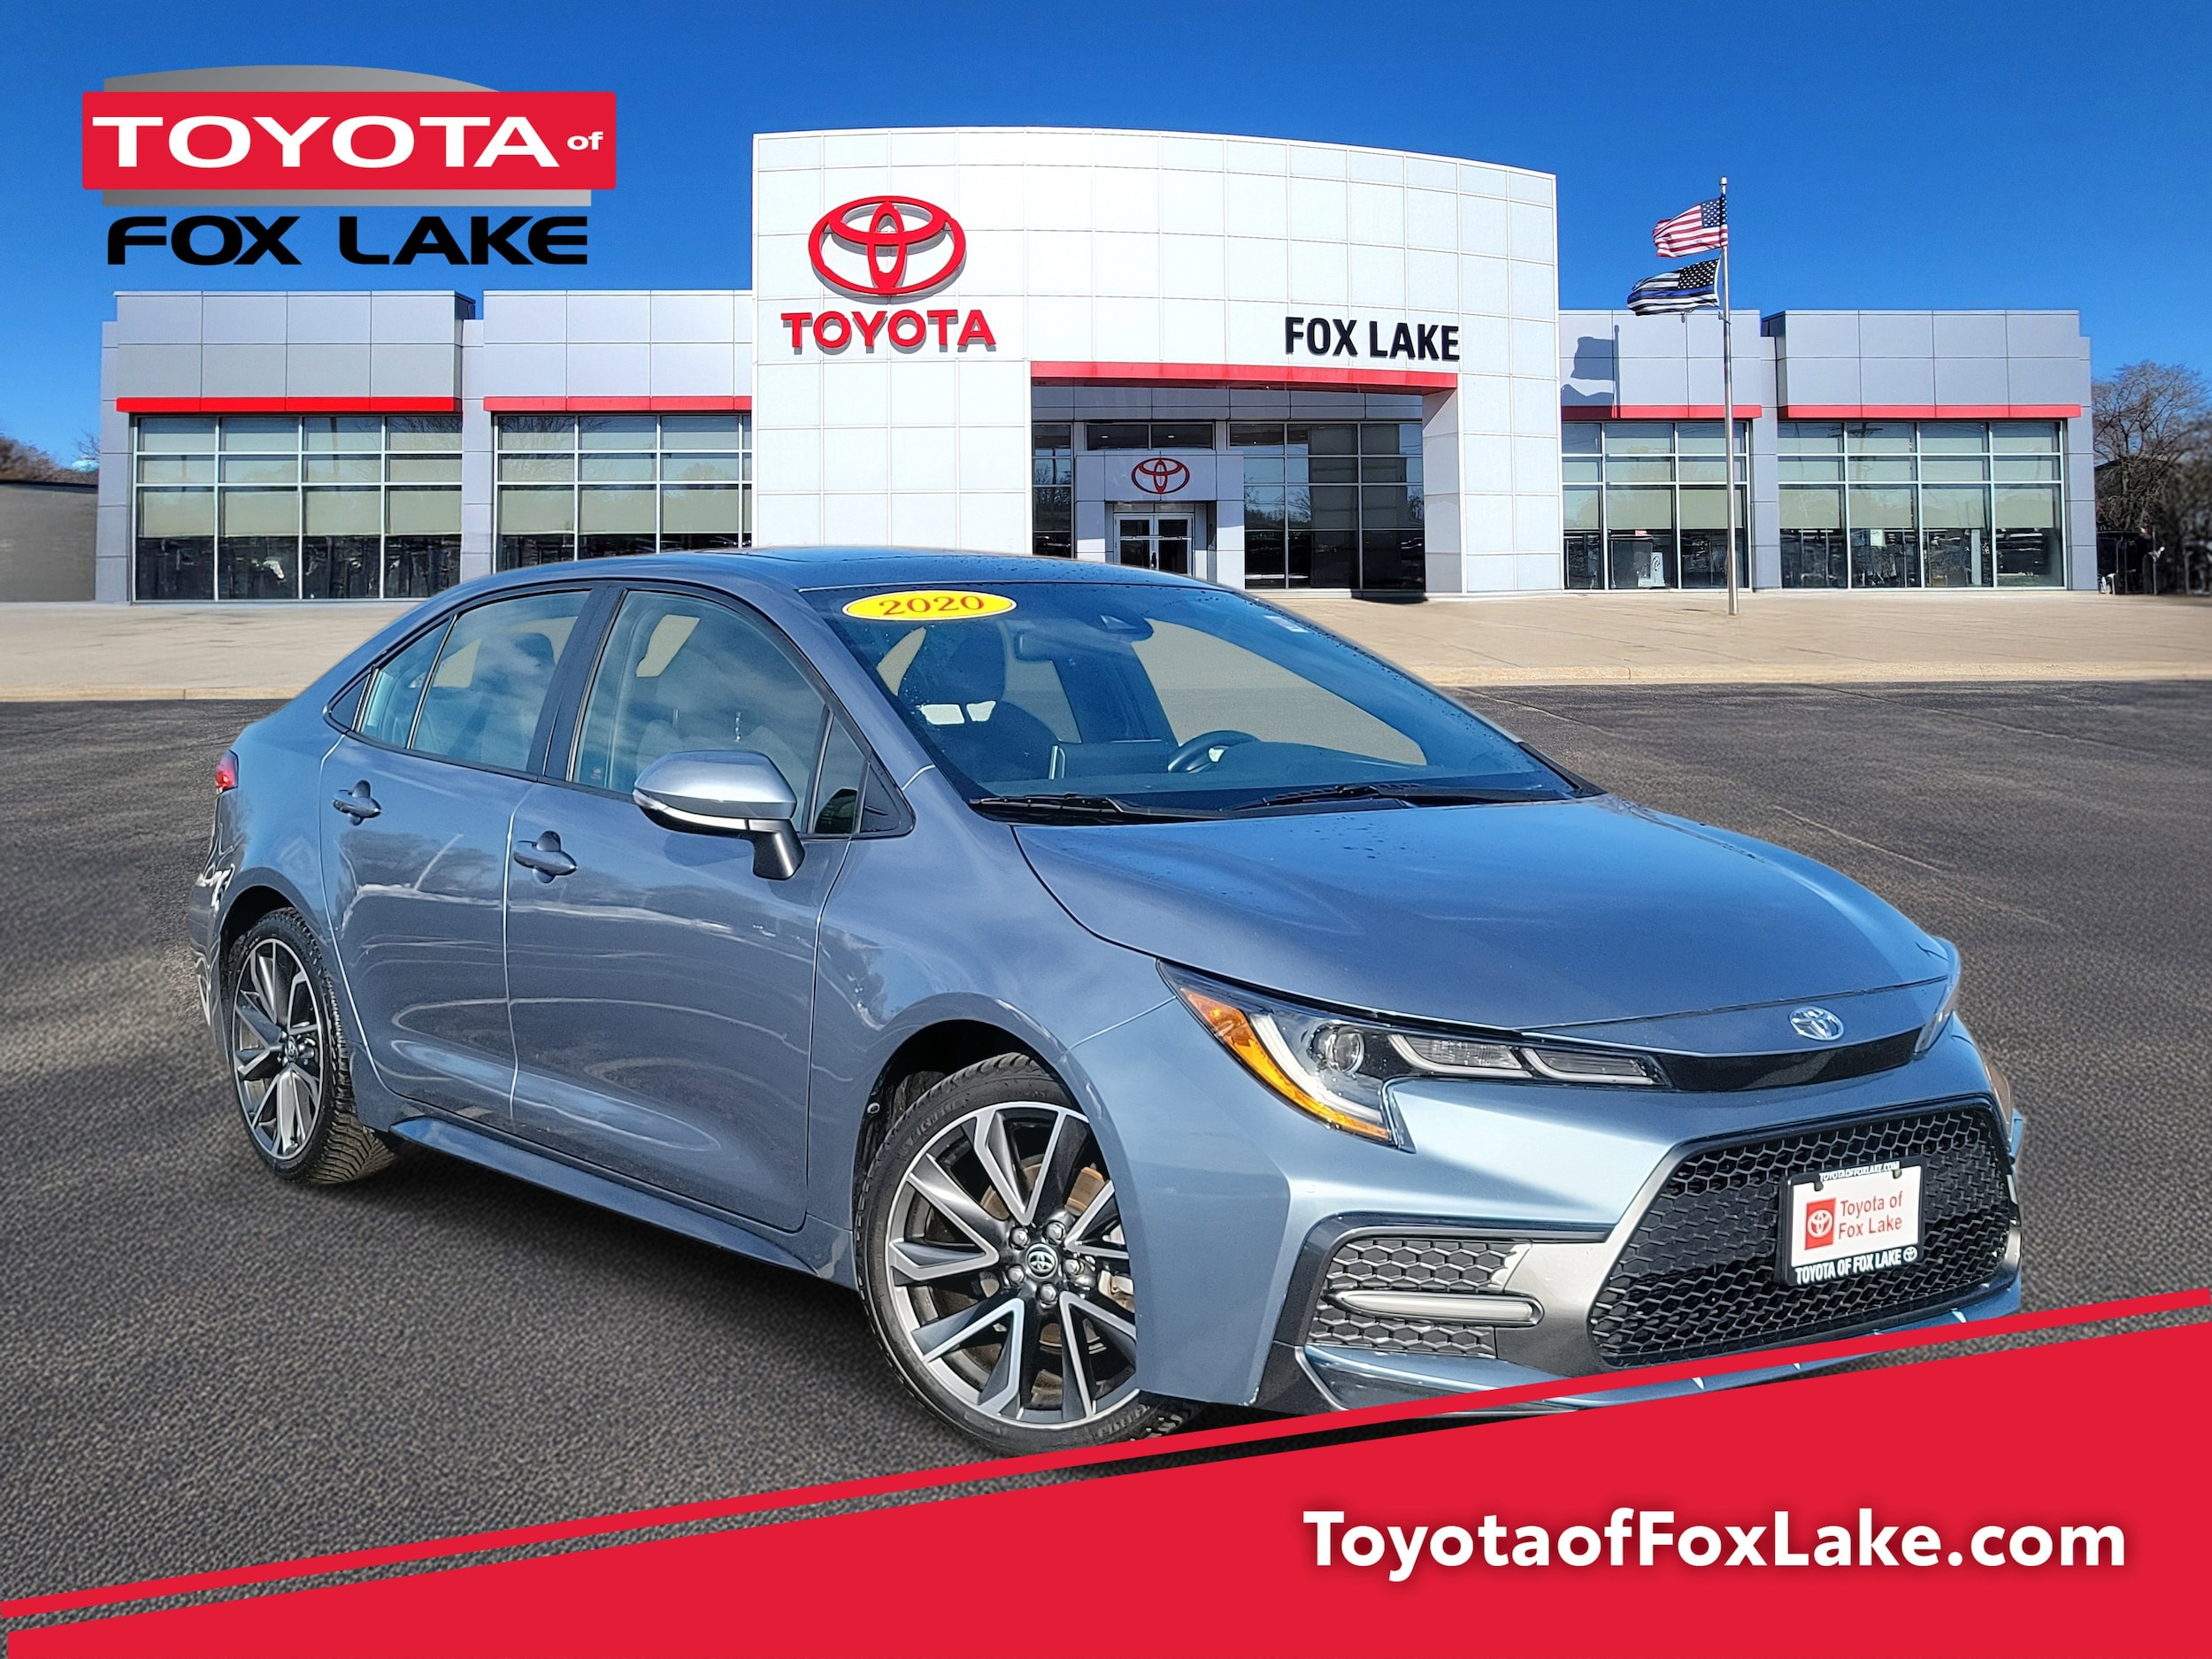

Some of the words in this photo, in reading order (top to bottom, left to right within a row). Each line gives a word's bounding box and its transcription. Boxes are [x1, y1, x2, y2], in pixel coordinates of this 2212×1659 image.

[780, 309, 997, 351] TOYOTA
[1285, 316, 1358, 357] FOX
[1369, 320, 1460, 361] LAKE
[879, 595, 985, 616] 2020
[1840, 1195, 1885, 1218] Toyota
[1890, 1191, 1903, 1208] of
[1839, 1223, 1863, 1239] Fox
[1869, 1216, 1902, 1233] Lake
[1795, 1263, 1836, 1285] TOYOTA
[1837, 1257, 1853, 1277] OF
[1853, 1253, 1874, 1273] FOX
[1875, 1248, 1901, 1269] LAKE
